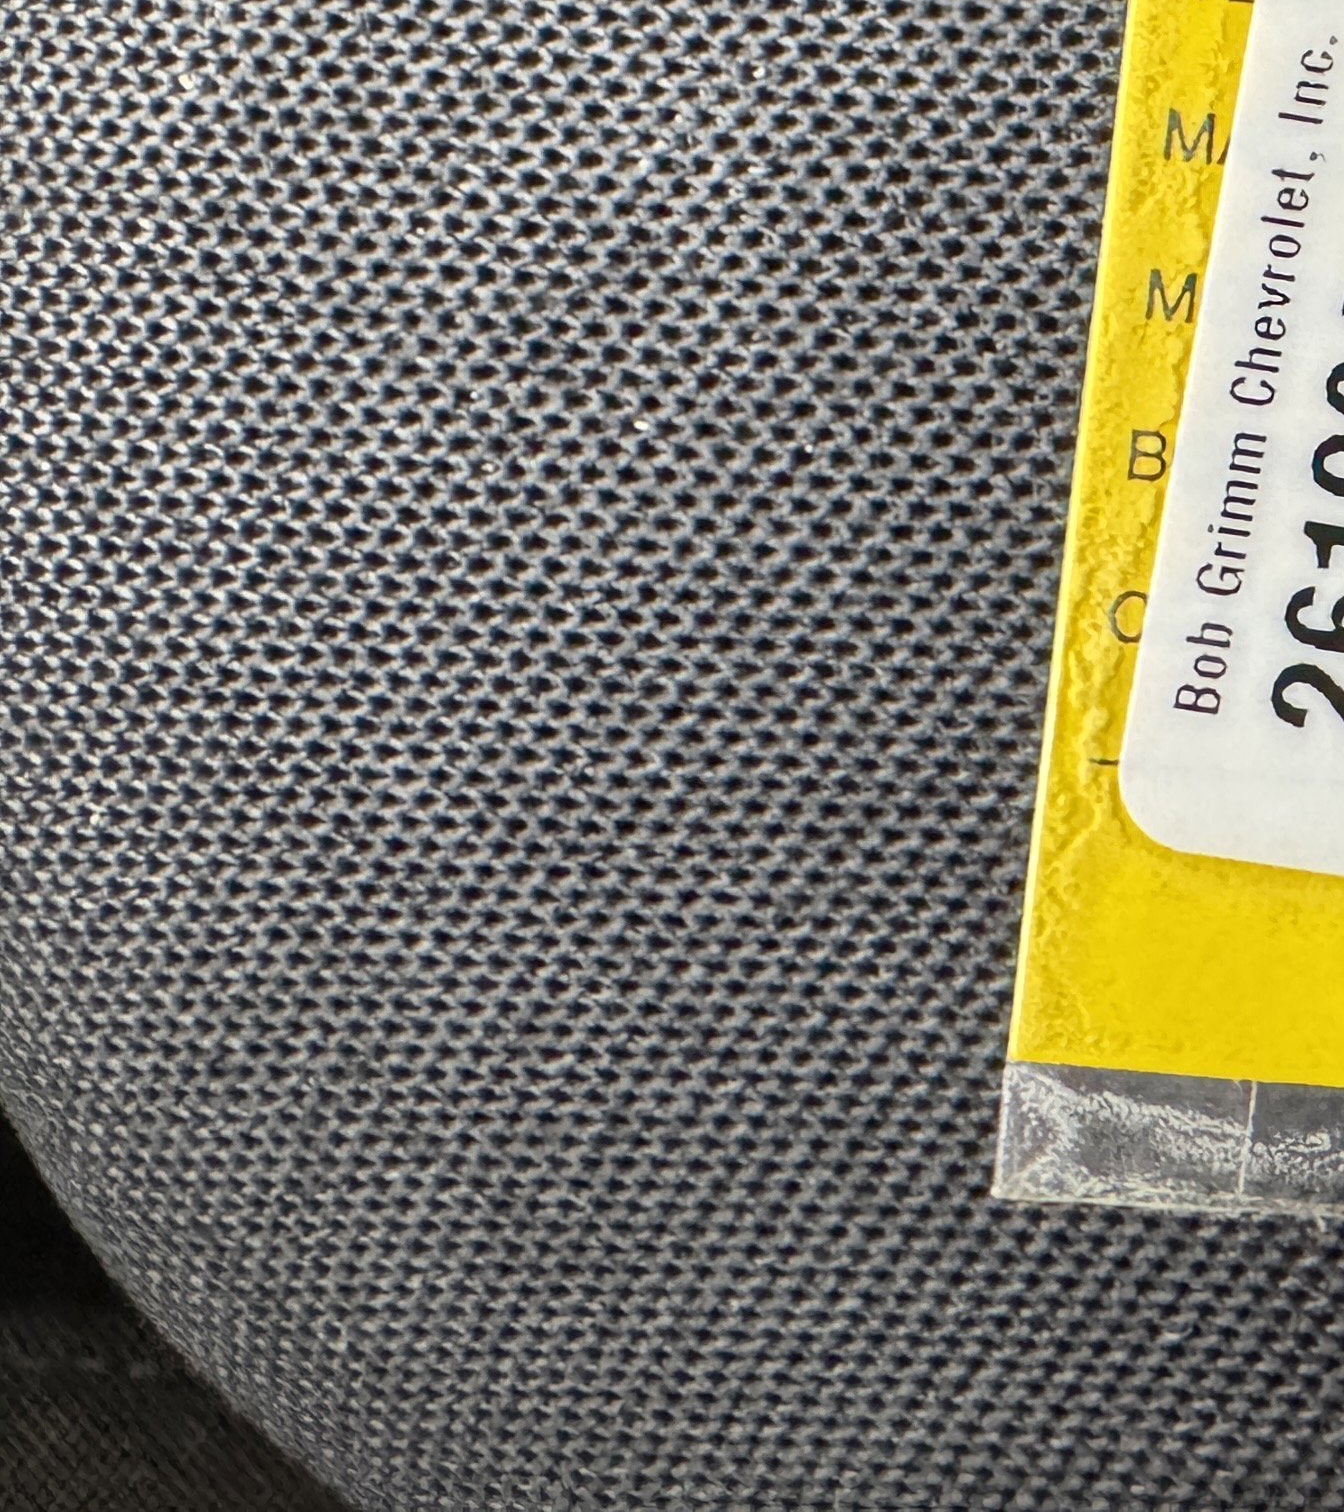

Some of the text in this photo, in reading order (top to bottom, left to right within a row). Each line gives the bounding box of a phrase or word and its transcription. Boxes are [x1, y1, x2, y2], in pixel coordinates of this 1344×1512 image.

[1173, 35, 1340, 716] Bob Grimm Chevrolet, Inc.
